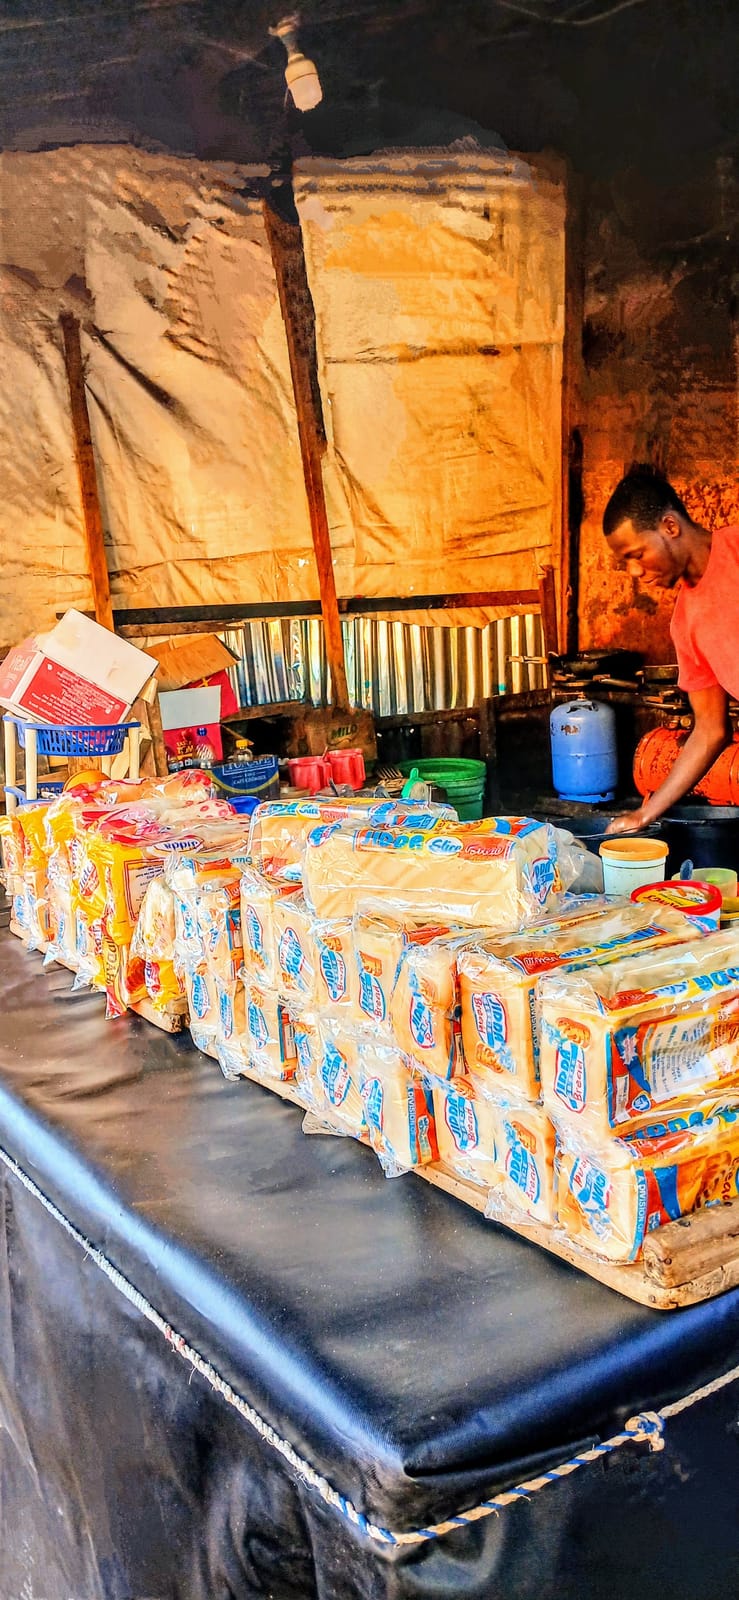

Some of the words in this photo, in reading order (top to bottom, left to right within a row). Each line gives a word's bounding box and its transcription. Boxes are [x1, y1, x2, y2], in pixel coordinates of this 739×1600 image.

[330, 724, 357, 739] MILO
[361, 830, 424, 849] JIDDA
[428, 838, 462, 851] Slice
[473, 996, 486, 1034] Bread
[488, 996, 504, 1044] JIDDA
[334, 1067, 349, 1100] Bread
[556, 1047, 571, 1098] JIDDA
[573, 1059, 583, 1102] Bread
[447, 1096, 461, 1141] JIDDA
[467, 1107, 476, 1142] Bread
[509, 1147, 523, 1184] DDA
[638, 1183, 647, 1223] DIVISION
